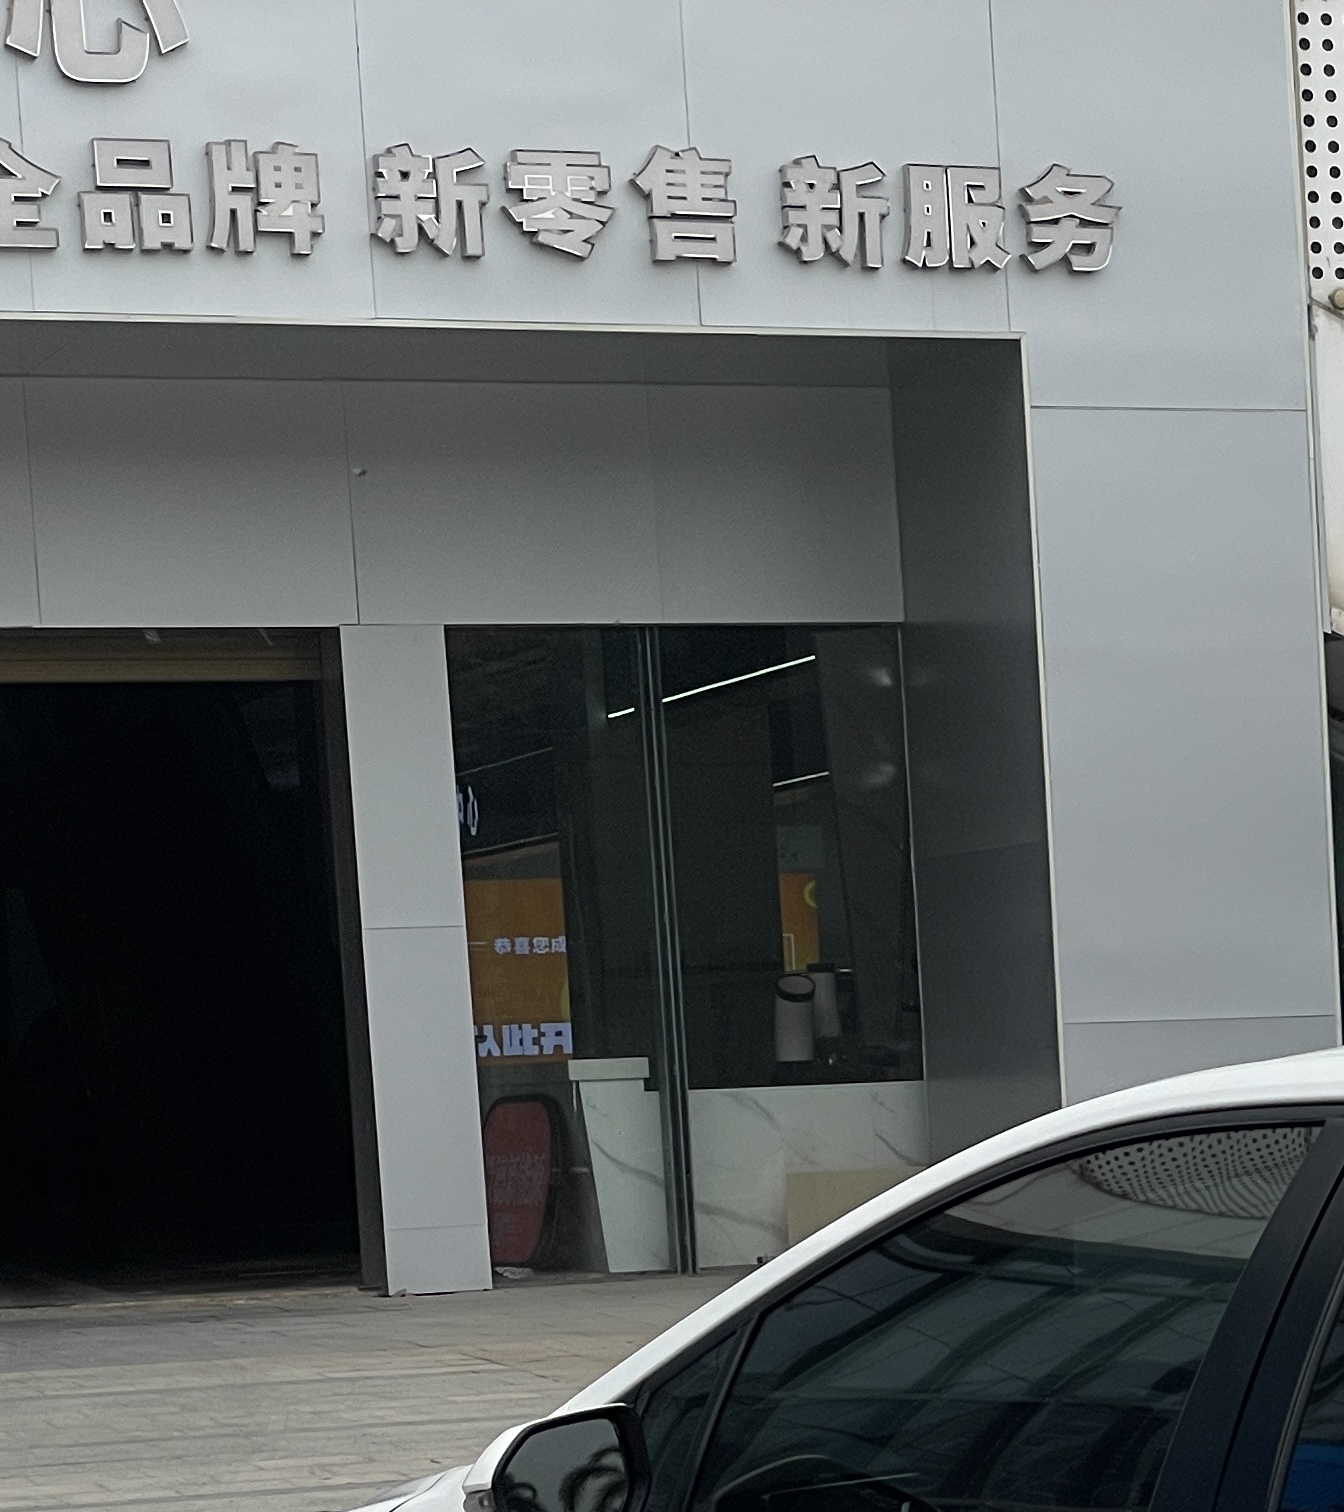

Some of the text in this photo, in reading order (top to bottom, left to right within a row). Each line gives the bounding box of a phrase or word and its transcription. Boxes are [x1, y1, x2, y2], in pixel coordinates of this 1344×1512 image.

[370, 143, 738, 264] 新零售
[777, 155, 1123, 273] 新服务
